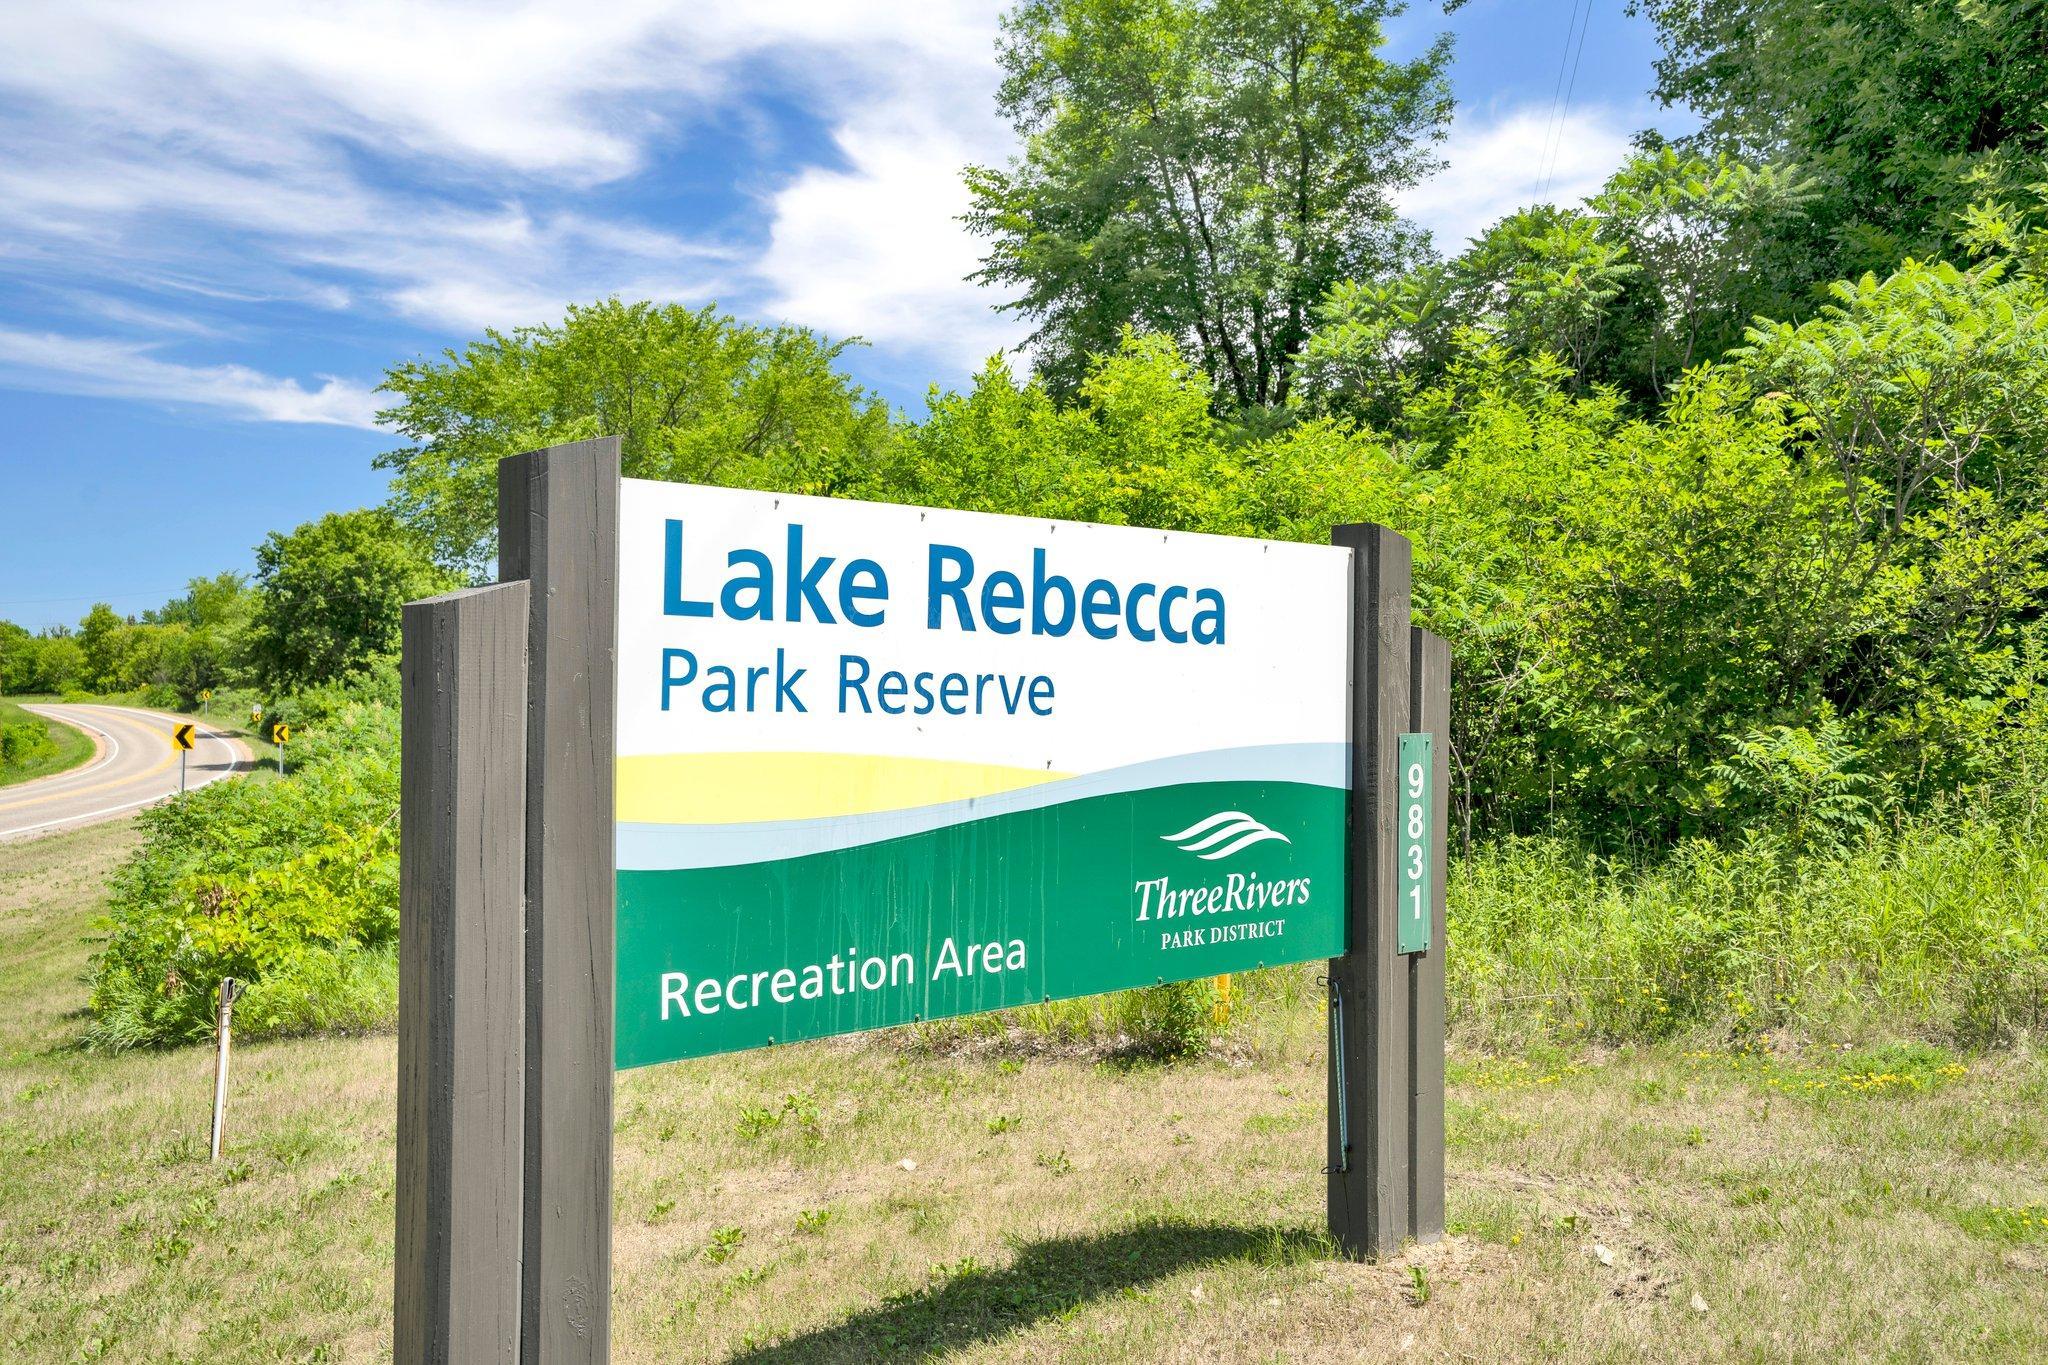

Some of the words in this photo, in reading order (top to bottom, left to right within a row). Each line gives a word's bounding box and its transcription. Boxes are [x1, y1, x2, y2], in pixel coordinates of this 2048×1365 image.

[663, 519, 889, 628] Lake
[927, 543, 1227, 645] Rebecca
[660, 648, 808, 713] Park
[838, 654, 1055, 716] Reserve
[1407, 763, 1424, 920] 9831
[1161, 928, 1206, 950] PARK
[1210, 919, 1285, 944] DISTRICT
[661, 948, 914, 1020] Recreation
[932, 938, 1026, 981] Area
